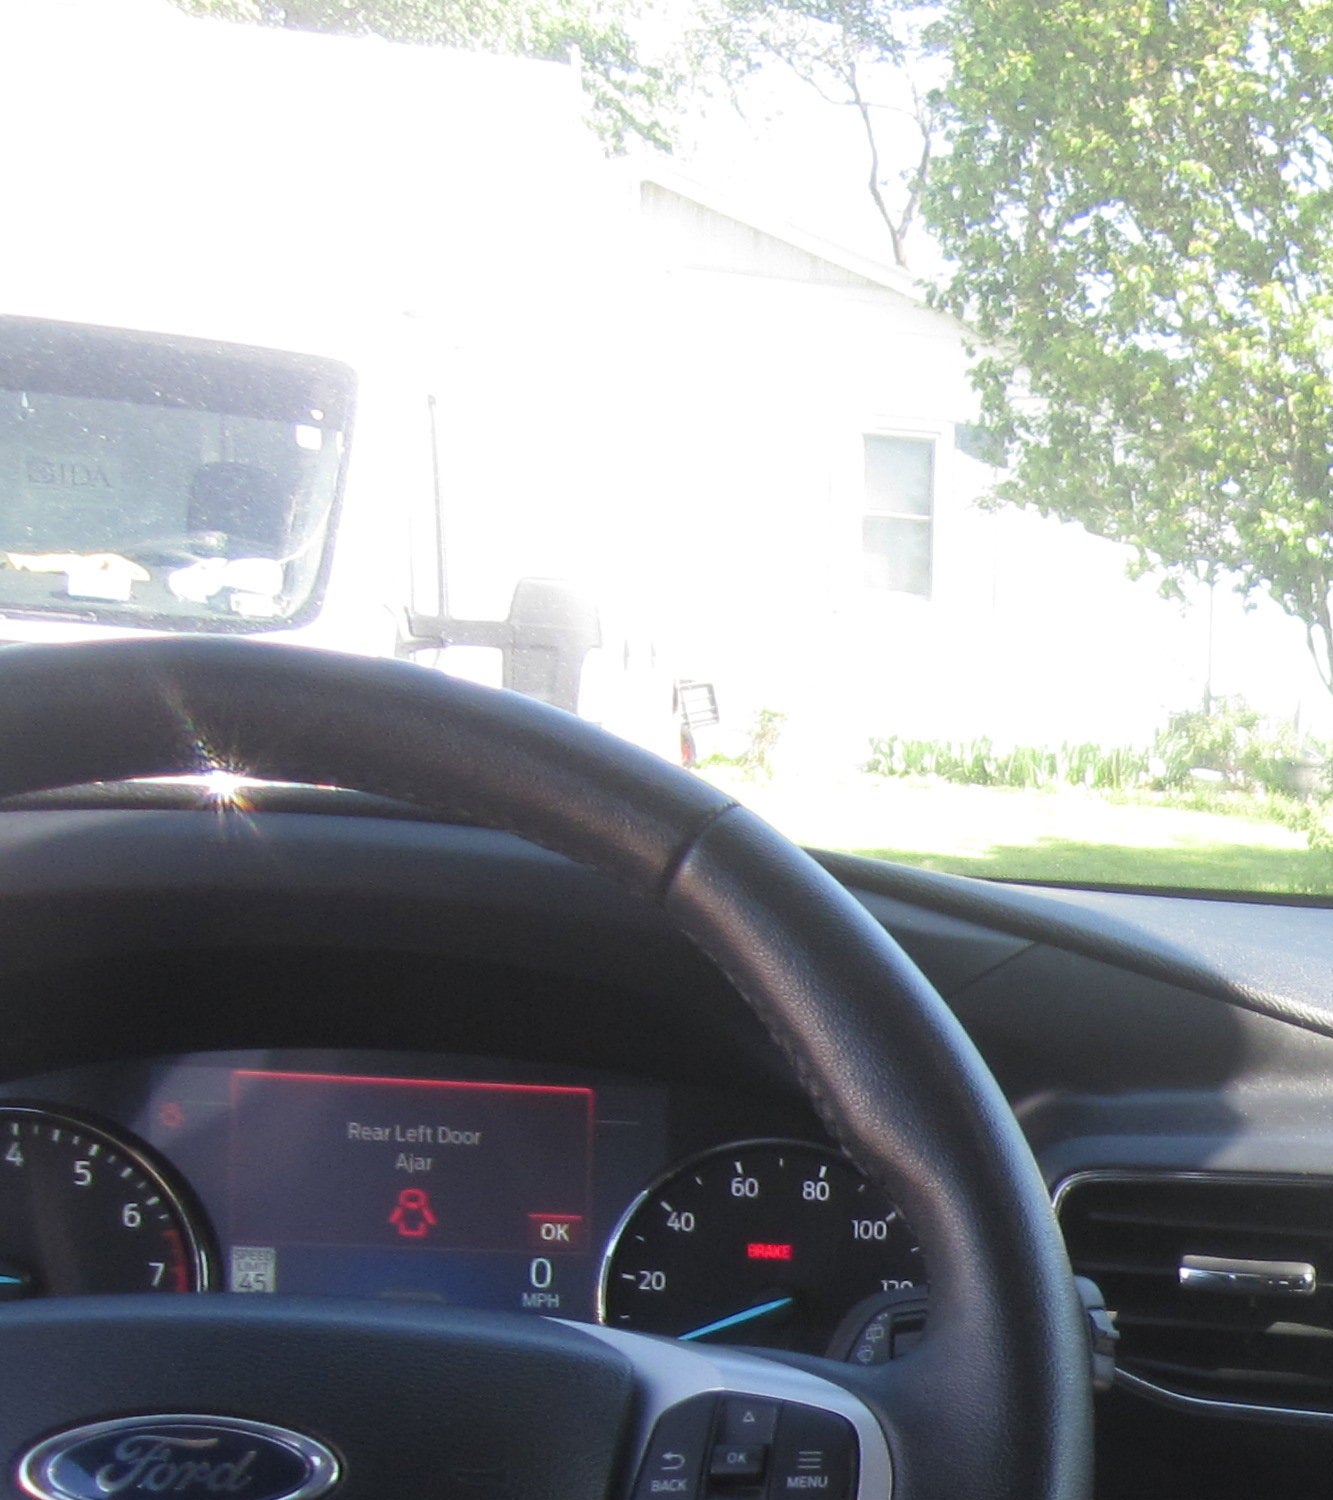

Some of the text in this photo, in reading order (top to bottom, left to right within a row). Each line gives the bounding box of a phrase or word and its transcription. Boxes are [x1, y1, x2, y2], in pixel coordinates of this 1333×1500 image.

[347, 1122, 482, 1145] Rear Left Door
[5, 1142, 24, 1167] 4
[396, 1153, 433, 1173] Ajar
[74, 1160, 92, 1186] 5
[730, 1177, 759, 1197] 60
[802, 1181, 830, 1201] 80
[122, 1203, 141, 1228] 6
[667, 1211, 695, 1232] 40
[540, 1223, 570, 1242] OK
[851, 1219, 887, 1240] 100
[747, 1243, 793, 1260] BRAKE
[148, 1262, 165, 1287] 7
[238, 1273, 266, 1293] 45
[529, 1257, 553, 1289] 0
[638, 1271, 667, 1291] 20
[522, 1292, 560, 1308] MPH
[95, 1434, 257, 1493] Ford
[726, 1451, 747, 1464] OK
[651, 1479, 688, 1493] BACK
[786, 1476, 828, 1489] MENU
